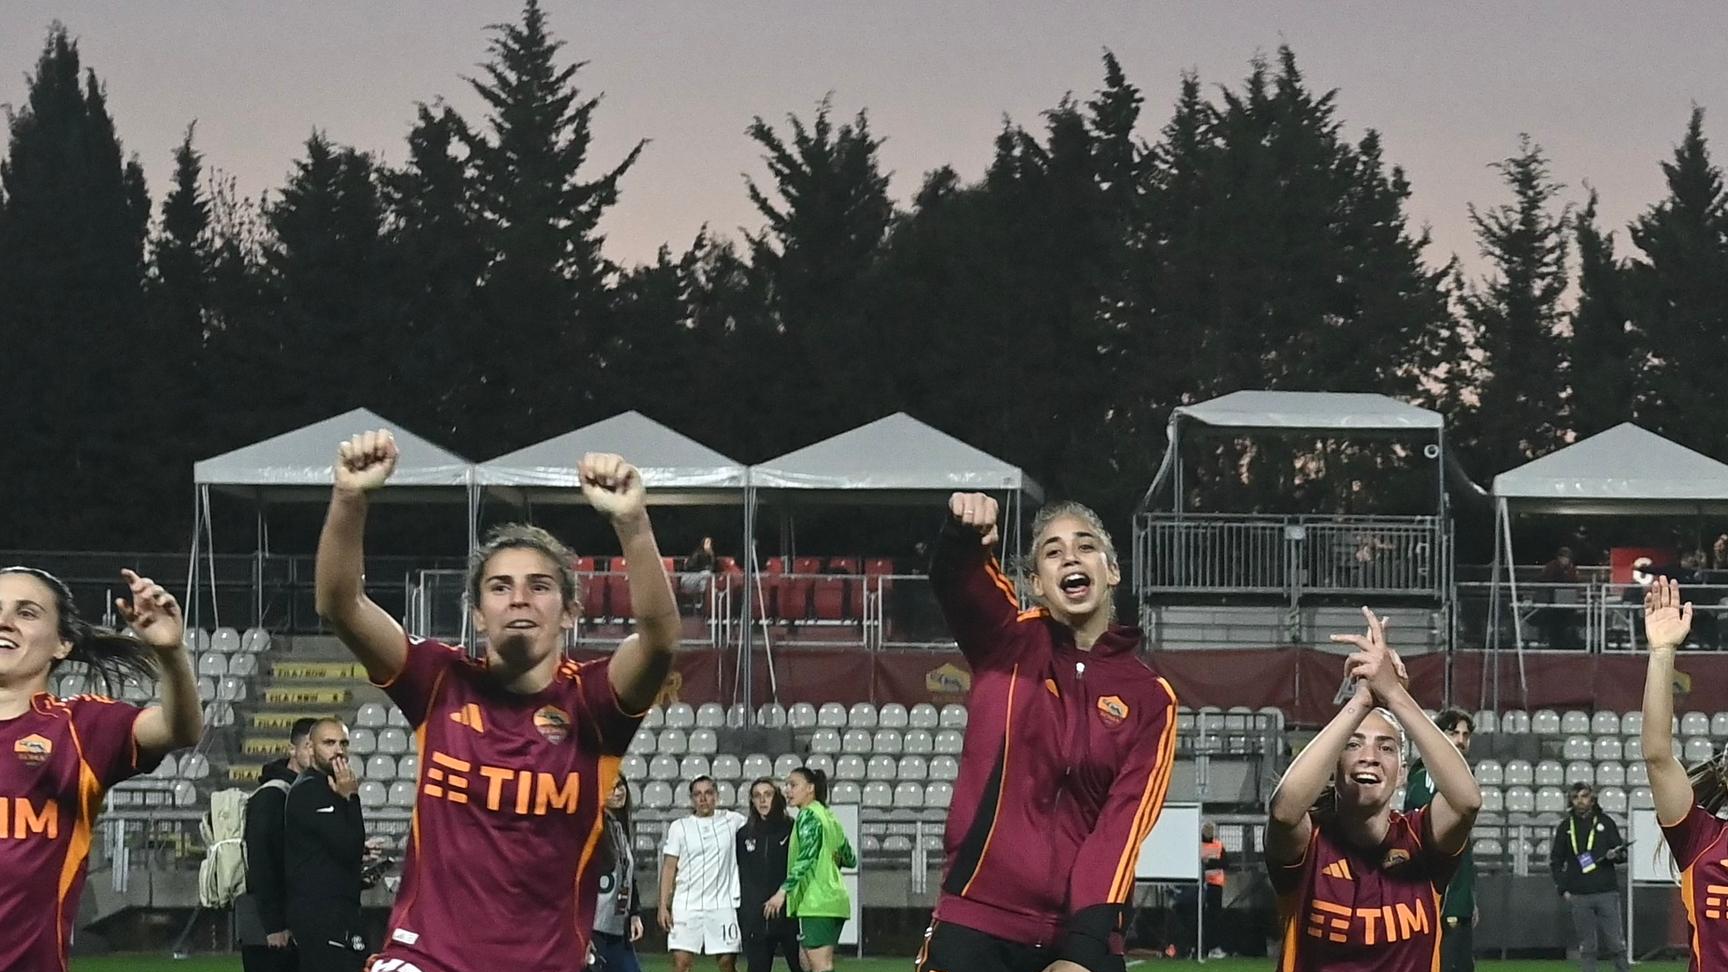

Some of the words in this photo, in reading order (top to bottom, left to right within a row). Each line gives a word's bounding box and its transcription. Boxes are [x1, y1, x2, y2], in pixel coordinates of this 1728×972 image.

[480, 764, 580, 816] TIM
[0, 797, 58, 839] IM
[722, 923, 739, 942] 10
[1357, 898, 1428, 946] TIM
